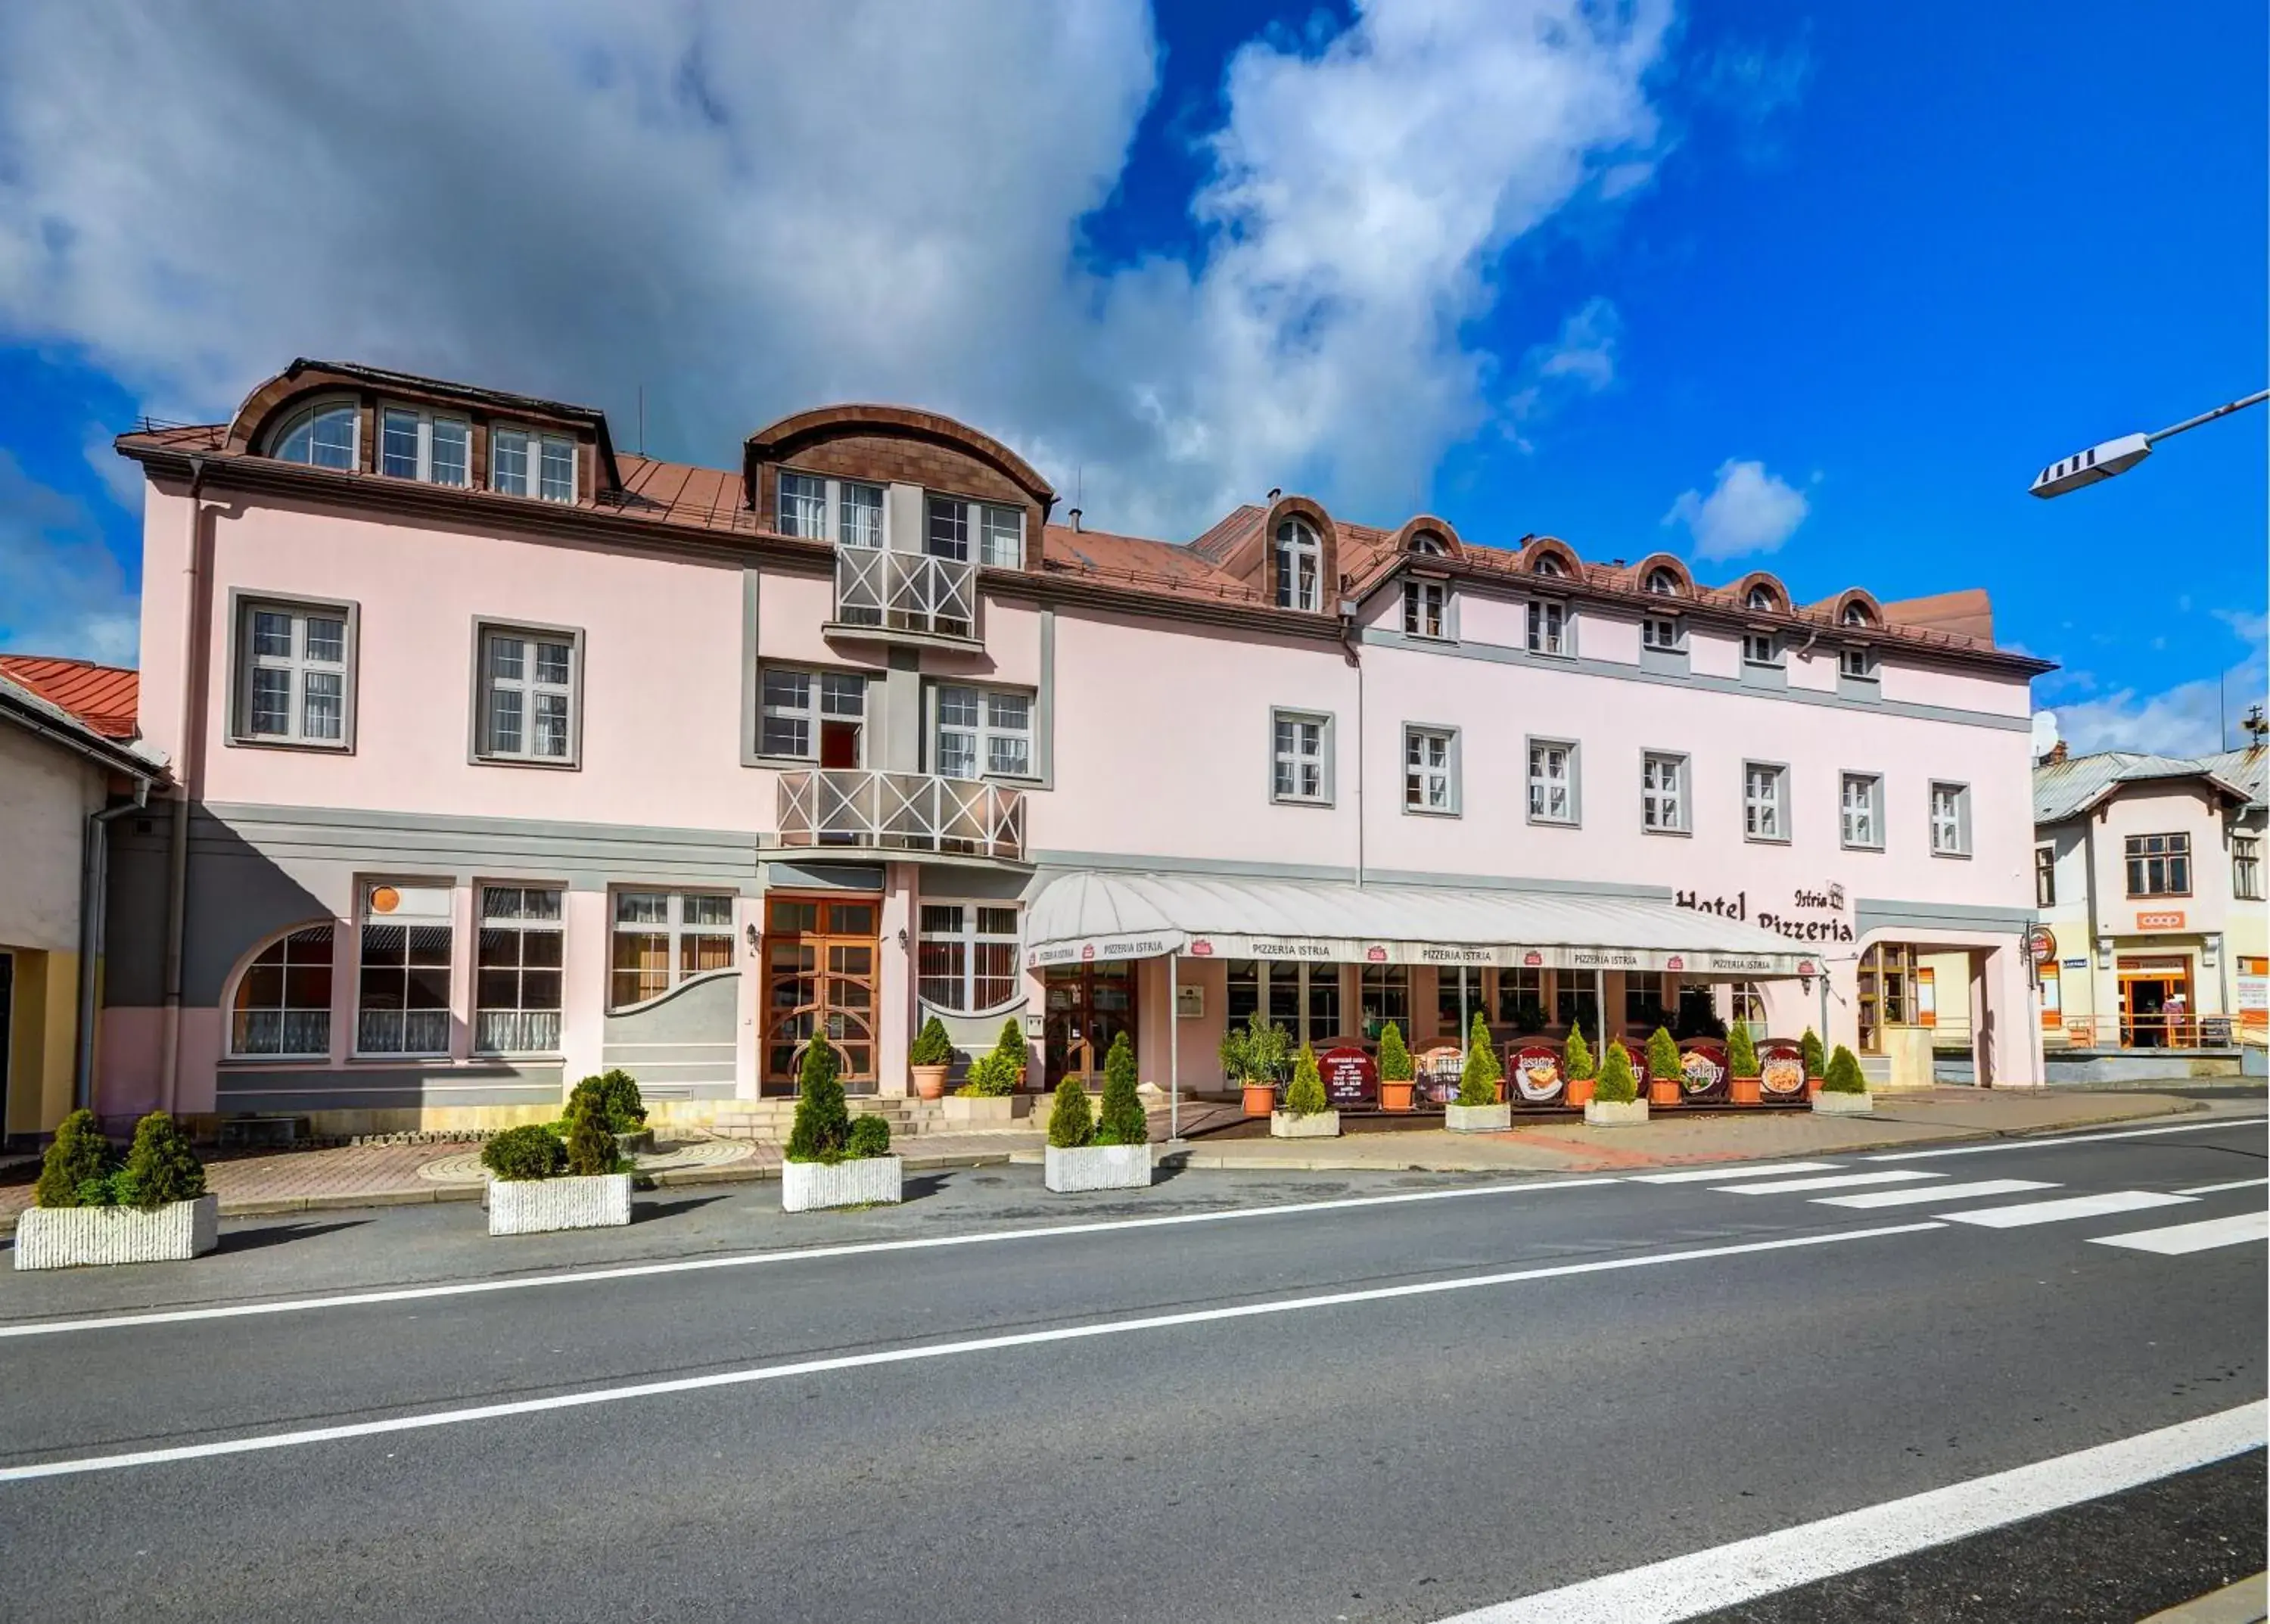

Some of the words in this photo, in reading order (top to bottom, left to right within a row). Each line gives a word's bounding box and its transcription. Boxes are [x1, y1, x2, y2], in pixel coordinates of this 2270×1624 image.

[1794, 889, 1827, 908] Istria
[1675, 890, 1746, 921] Hotel
[1757, 913, 1853, 942] Pizzeria
[1104, 942, 1135, 954] PIZZERIA
[1136, 941, 1163, 953] ISTRIA
[1252, 944, 1295, 954] PIZZERIA
[1298, 944, 1330, 956] ISTRIA
[1423, 949, 1460, 960] PIZZERIA
[1463, 950, 1491, 961] ISTRIA
[1575, 954, 1609, 965] PIZZERIA
[1611, 954, 1637, 965] ISTRIA
[1712, 959, 1744, 969] PIZZERIA
[1746, 960, 1770, 969] ISTRIA
